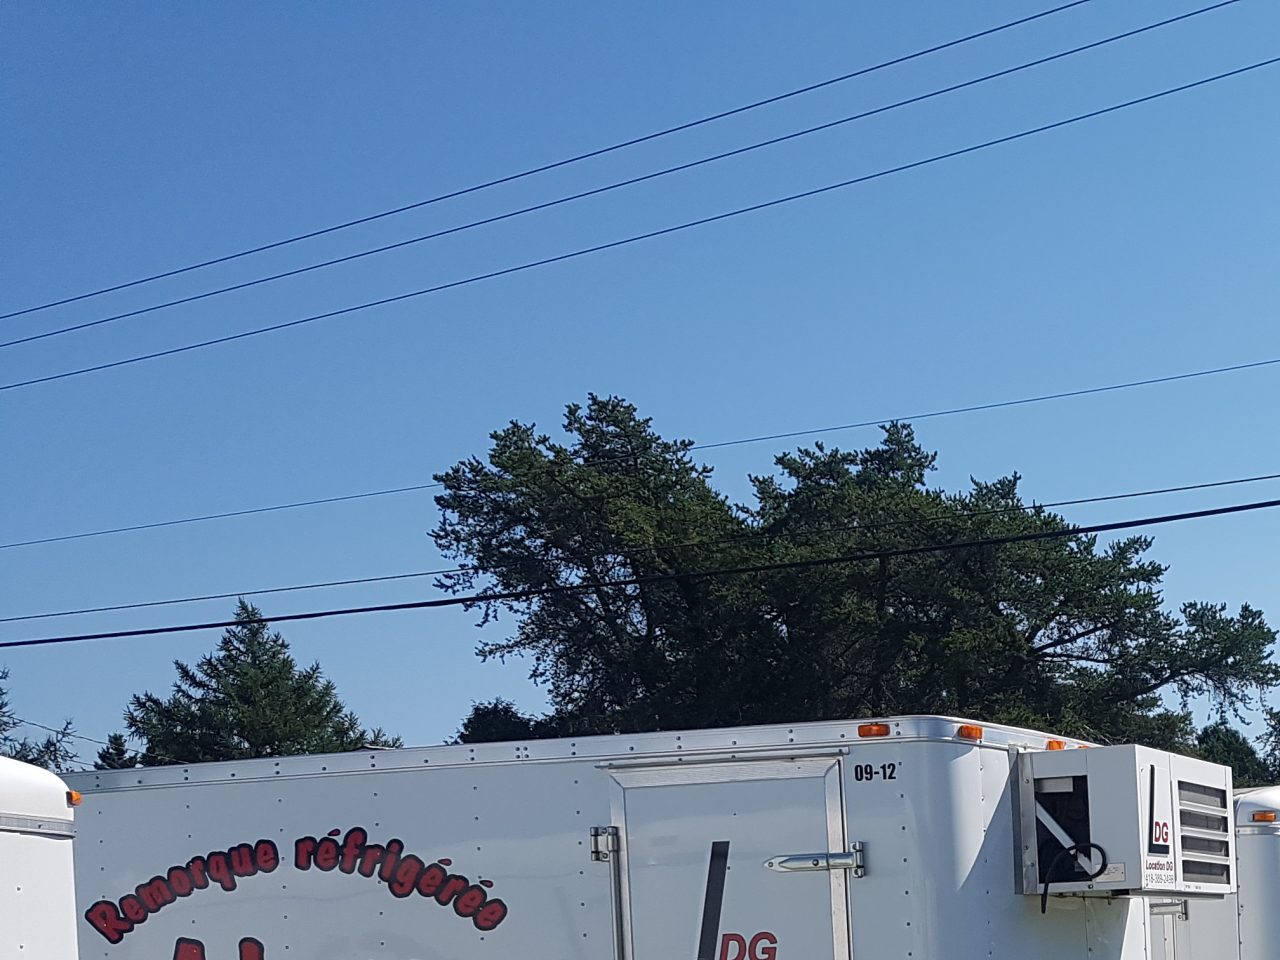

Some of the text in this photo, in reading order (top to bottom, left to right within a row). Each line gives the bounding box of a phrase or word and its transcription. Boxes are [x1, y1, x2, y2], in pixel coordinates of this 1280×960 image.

[854, 763, 897, 781] 09-12
[1154, 821, 1169, 843] DG
[1146, 860, 1174, 871] Location DG
[85, 827, 507, 944] Remorque réfrigérée
